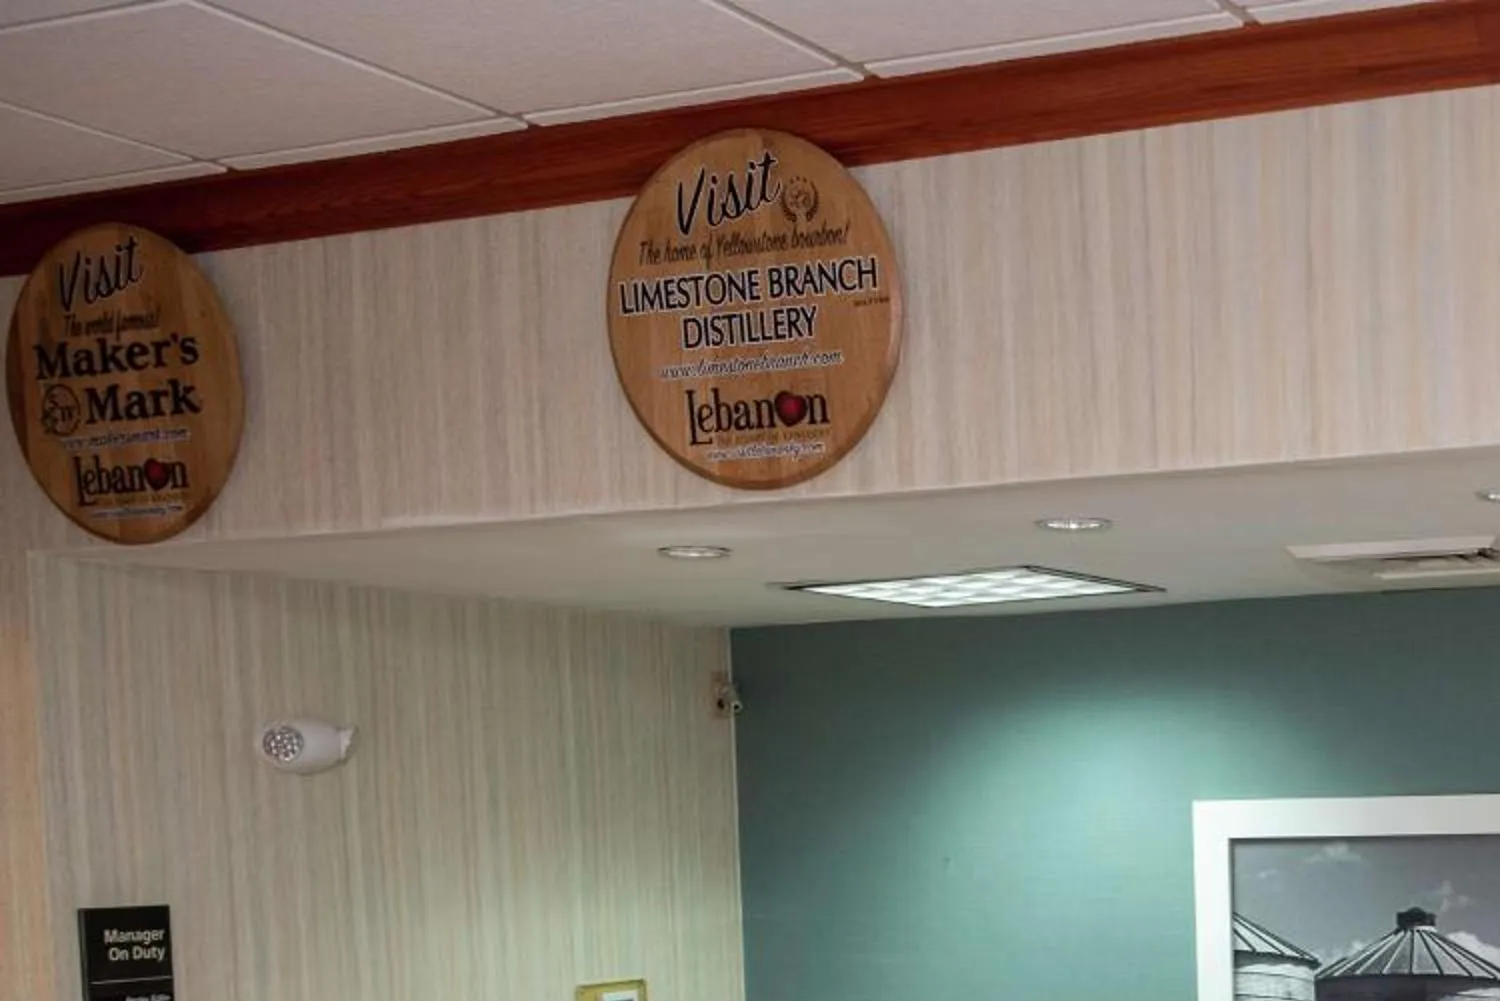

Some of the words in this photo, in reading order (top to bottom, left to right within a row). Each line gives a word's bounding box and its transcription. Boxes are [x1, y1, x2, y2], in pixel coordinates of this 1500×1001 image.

[676, 151, 781, 237] Visit
[58, 235, 145, 312] Visit
[620, 269, 761, 314] LIMESTONE
[769, 257, 878, 299] BRANCH
[683, 305, 817, 349] DISTILLERY
[32, 331, 200, 381] Maker's
[84, 378, 203, 425] Mark
[685, 387, 831, 446] Lebanon
[72, 454, 190, 506] Lebanon
[104, 928, 165, 945] Manager
[108, 946, 129, 961] On
[132, 944, 166, 962] Duty
